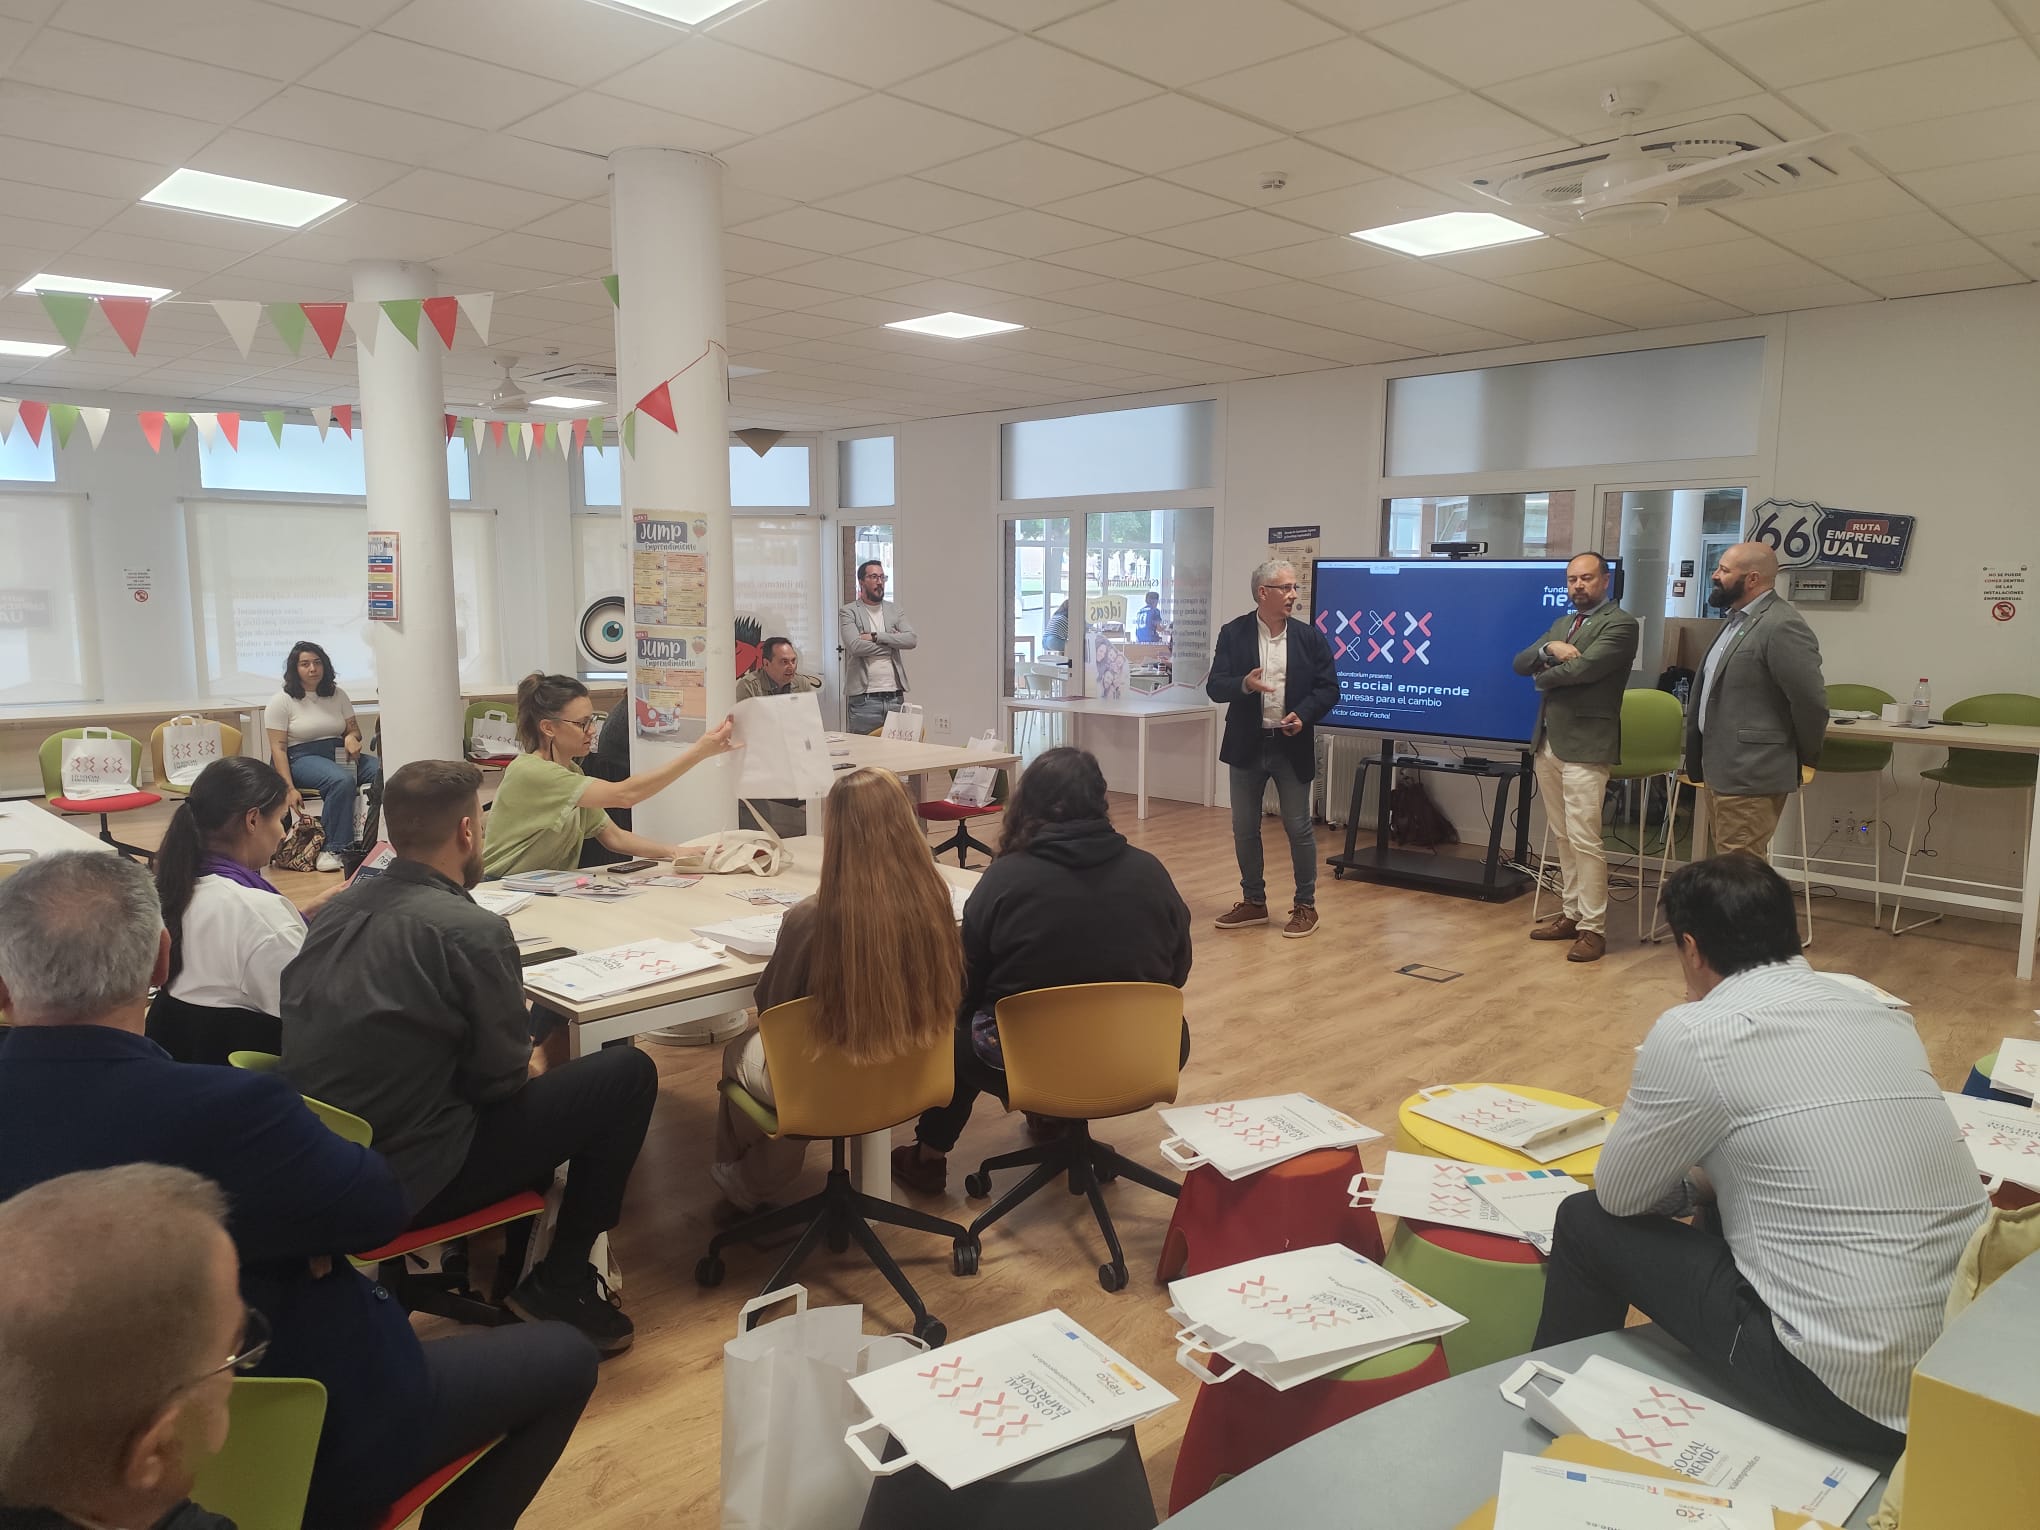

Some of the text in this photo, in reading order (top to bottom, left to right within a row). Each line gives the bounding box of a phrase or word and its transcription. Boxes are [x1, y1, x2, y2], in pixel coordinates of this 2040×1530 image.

[1755, 512, 1810, 558] 66
[1852, 523, 1881, 531] RUTA
[1826, 529, 1901, 546] EMPRENDE
[645, 542, 697, 552] Emprendimiento
[1823, 539, 1869, 559] UAL
[1543, 585, 1569, 593] funda
[1542, 593, 1569, 607] ne
[1353, 680, 1393, 692] social
[1398, 683, 1470, 697] emprende
[1376, 696, 1396, 704] para
[1398, 696, 1406, 704] el
[1408, 697, 1442, 707] cambio
[1004, 1376, 1062, 1421] LO SOCIAL
[1015, 1372, 1072, 1416] EMPRENDE
